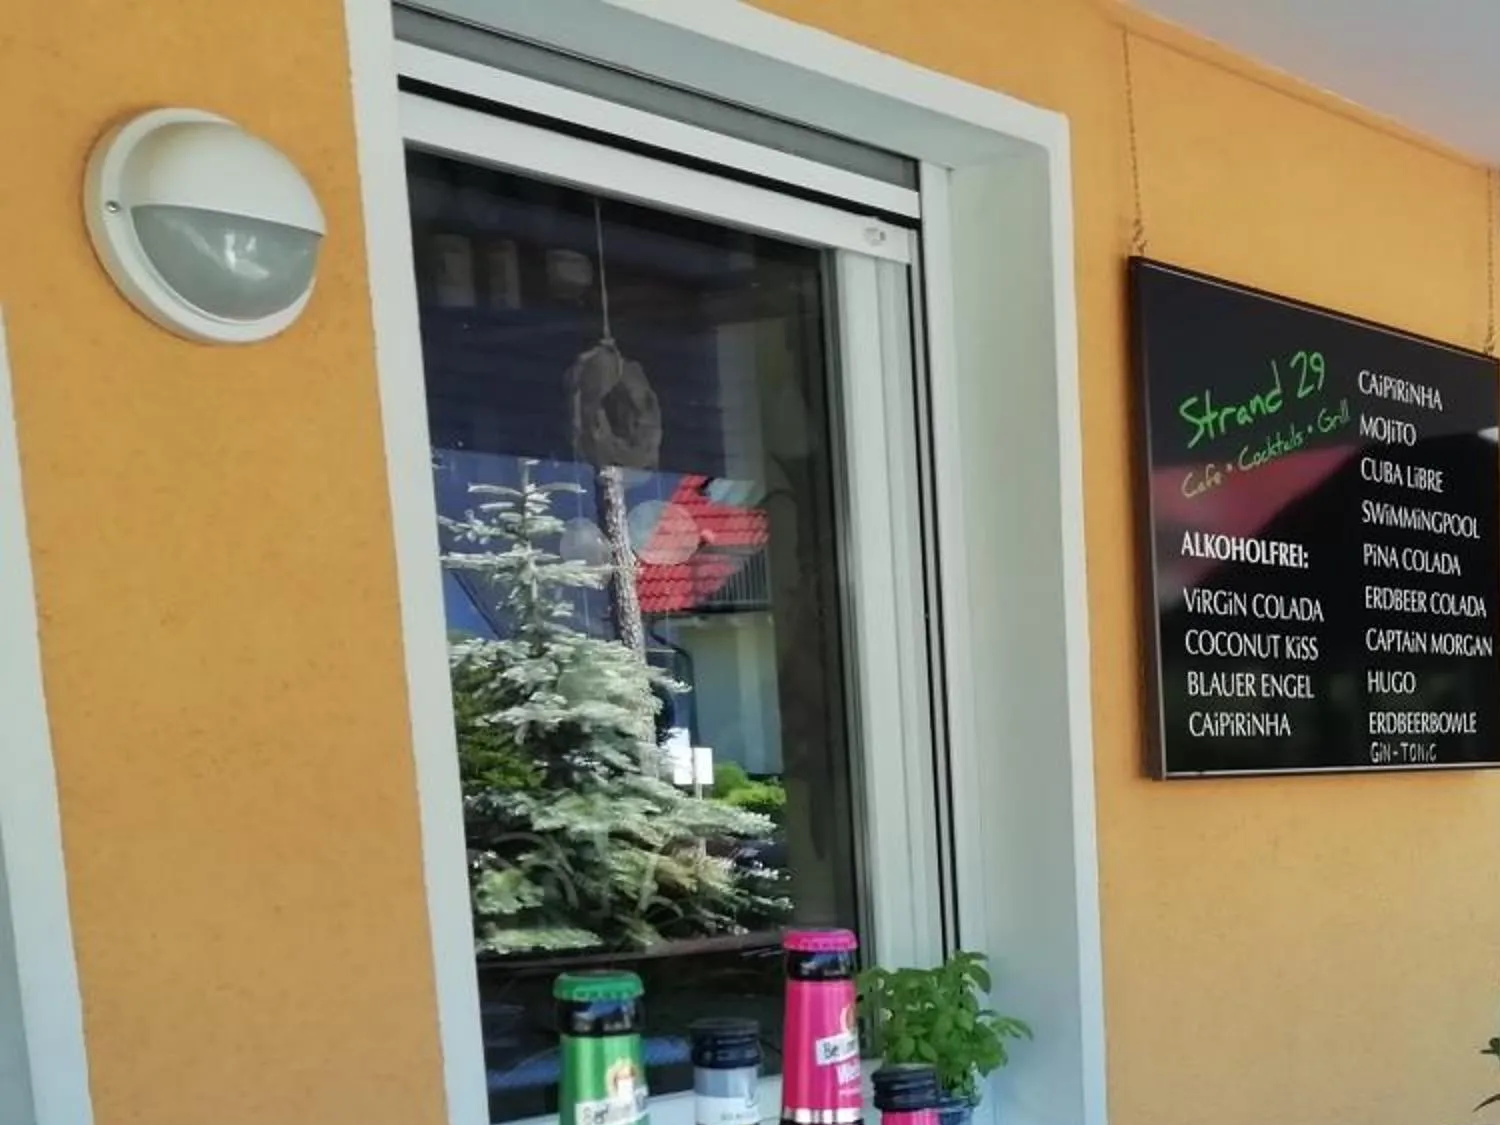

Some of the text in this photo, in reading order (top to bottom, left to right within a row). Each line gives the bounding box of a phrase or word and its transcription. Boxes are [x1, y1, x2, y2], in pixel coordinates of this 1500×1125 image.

[1179, 351, 1325, 449] Strand 29
[1361, 456, 1404, 487] CUBA
[1181, 529, 1310, 569] ALKOHOLFREI:
[1402, 547, 1461, 576] COLADA
[1252, 593, 1325, 622] COLADA
[1365, 585, 1487, 618] ERDBEER COLADA
[1185, 629, 1281, 659] COCONUT
[1431, 633, 1493, 657] MORGAN
[1187, 671, 1315, 699] BLAUER ENGEL
[1367, 670, 1417, 694] HUGO
[1369, 711, 1477, 734] ERDBEERBOWLE
